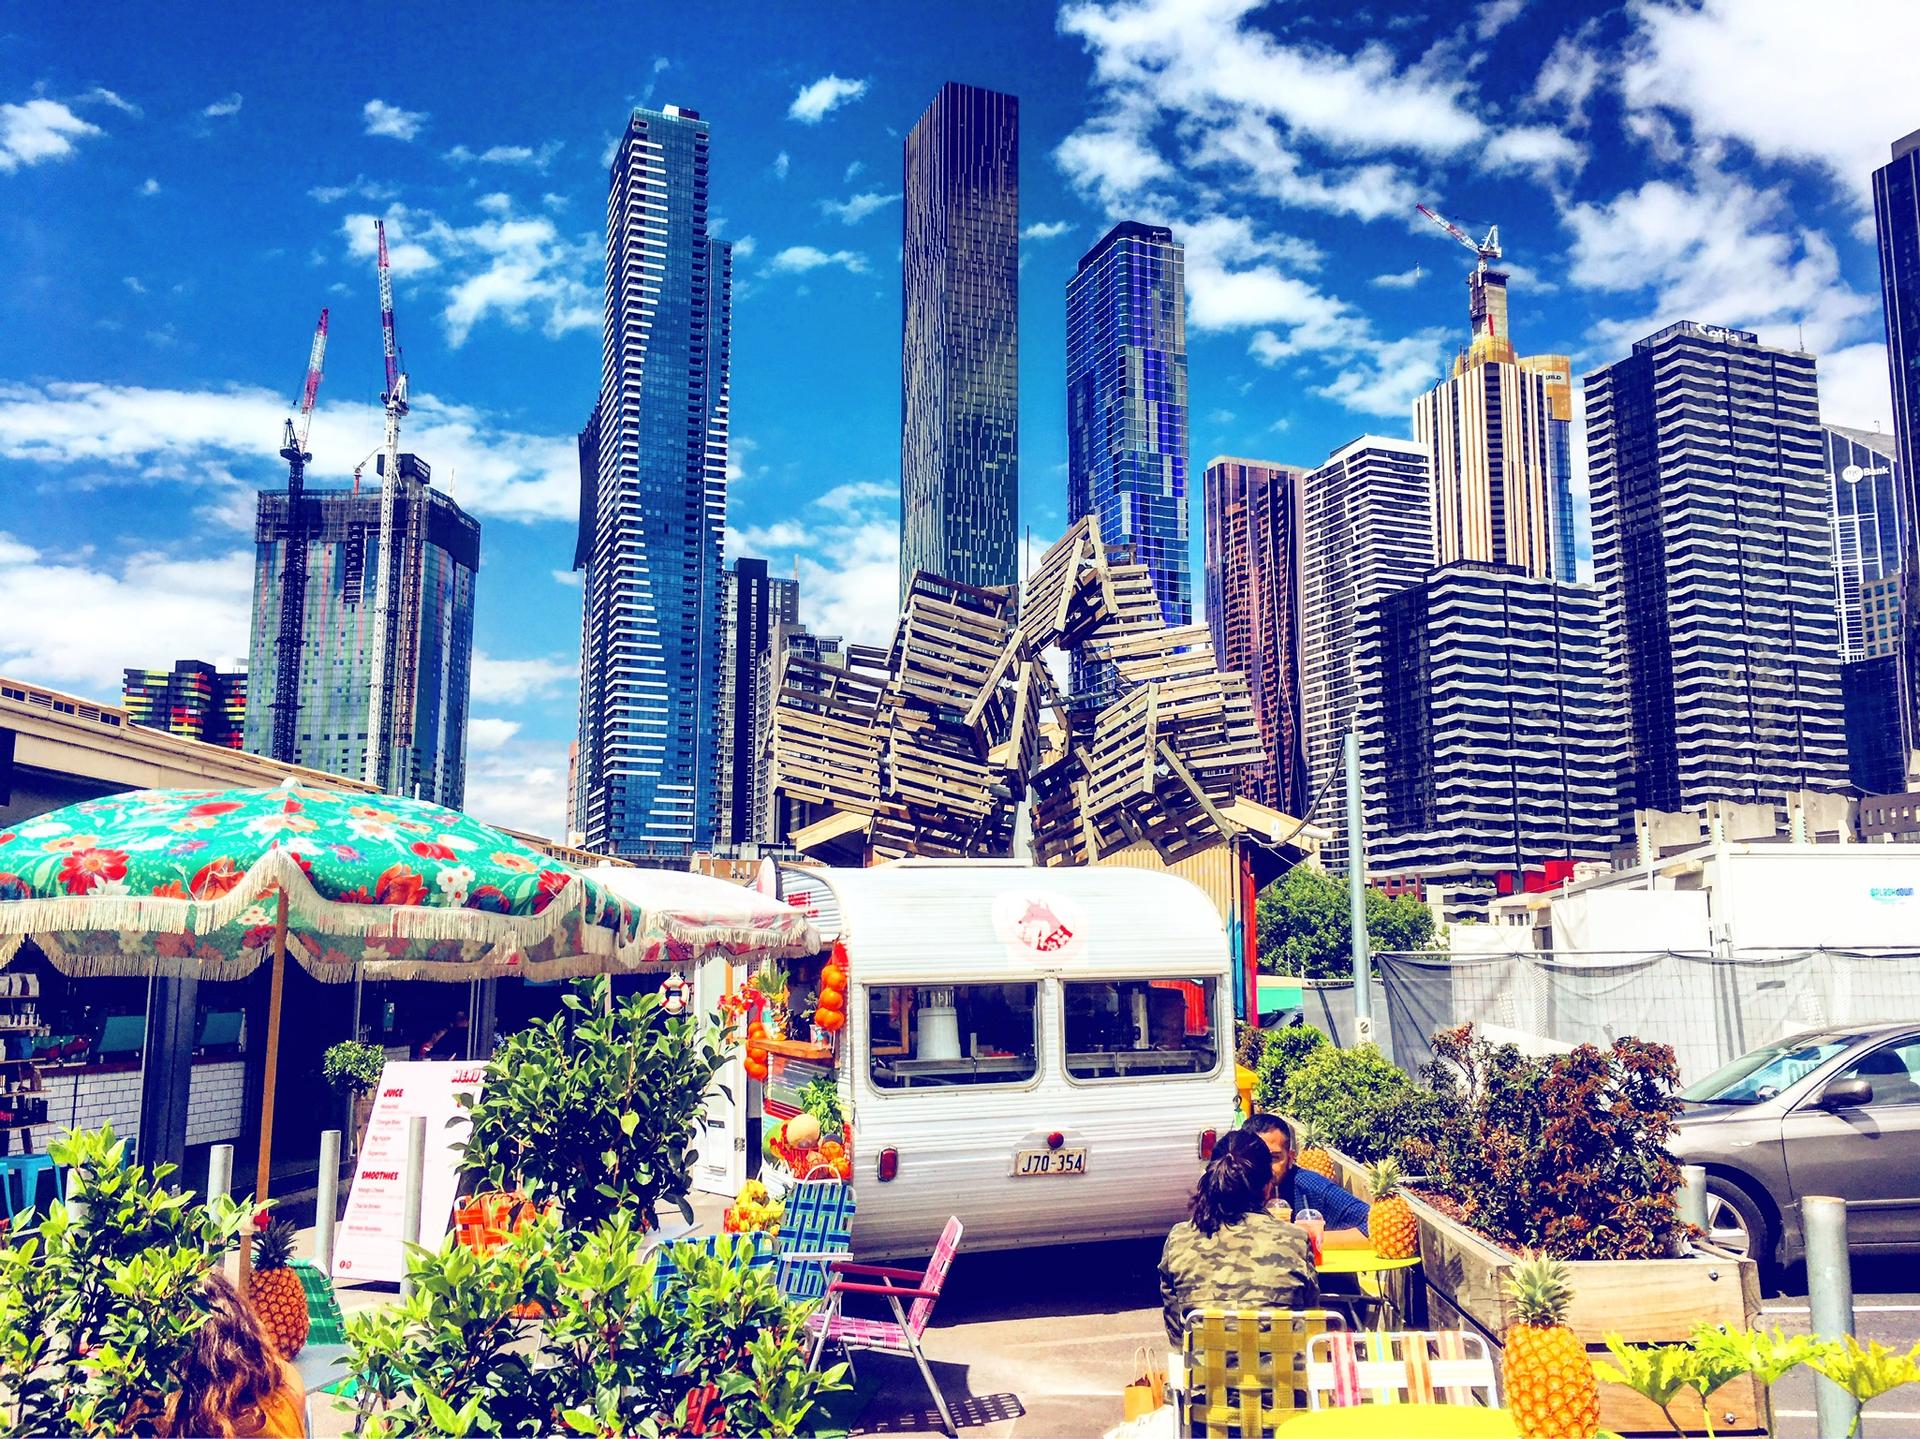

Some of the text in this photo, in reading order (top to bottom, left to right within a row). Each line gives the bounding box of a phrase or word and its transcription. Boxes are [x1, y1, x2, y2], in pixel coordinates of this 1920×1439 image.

[1863, 465, 1890, 476] Bank
[452, 1069, 481, 1084] MENU
[383, 1088, 404, 1098] JUICE
[361, 1170, 399, 1181] SMOOTHIES
